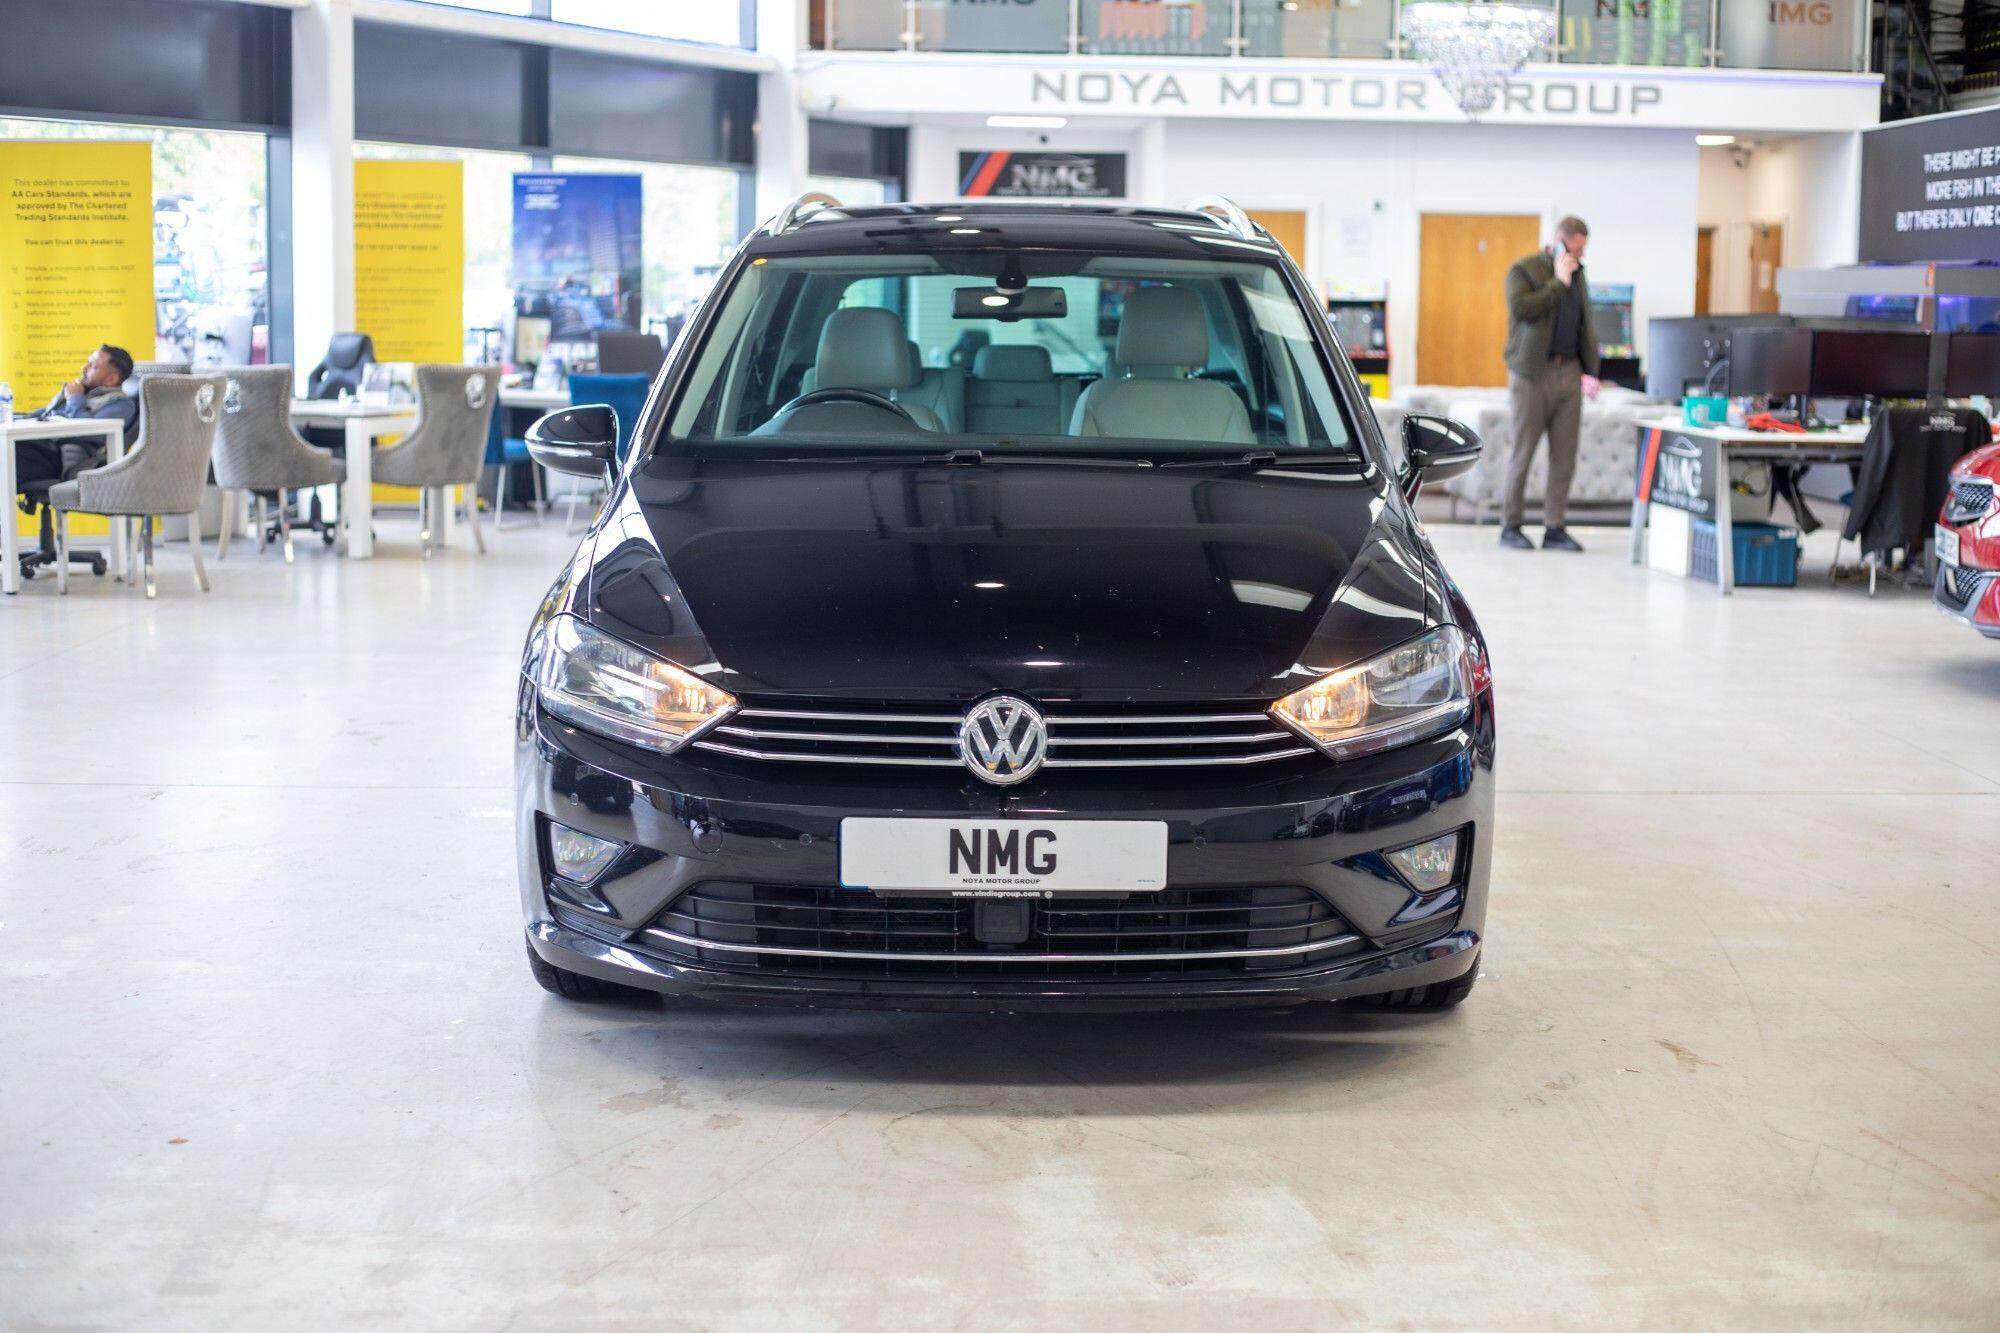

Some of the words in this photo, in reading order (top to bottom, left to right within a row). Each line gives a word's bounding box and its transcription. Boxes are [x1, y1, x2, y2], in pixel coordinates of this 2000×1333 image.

[1032, 73, 1188, 104] NOYA
[1220, 76, 1426, 110] MOTOR
[1012, 163, 1096, 190] NMG
[14, 178, 30, 186] This
[11, 190, 23, 198] AA
[25, 190, 44, 198] Cars
[93, 190, 116, 198] which
[119, 190, 131, 198] are
[16, 202, 56, 211] approved
[57, 202, 66, 211] by
[69, 202, 84, 211] The
[86, 202, 127, 211] Chartered
[15, 213, 46, 222] Trading
[48, 213, 90, 222] Standards
[1659, 451, 1702, 499] NMG
[949, 828, 1057, 875] NMG
[952, 890, 1041, 898] www.vindisgroup.com
